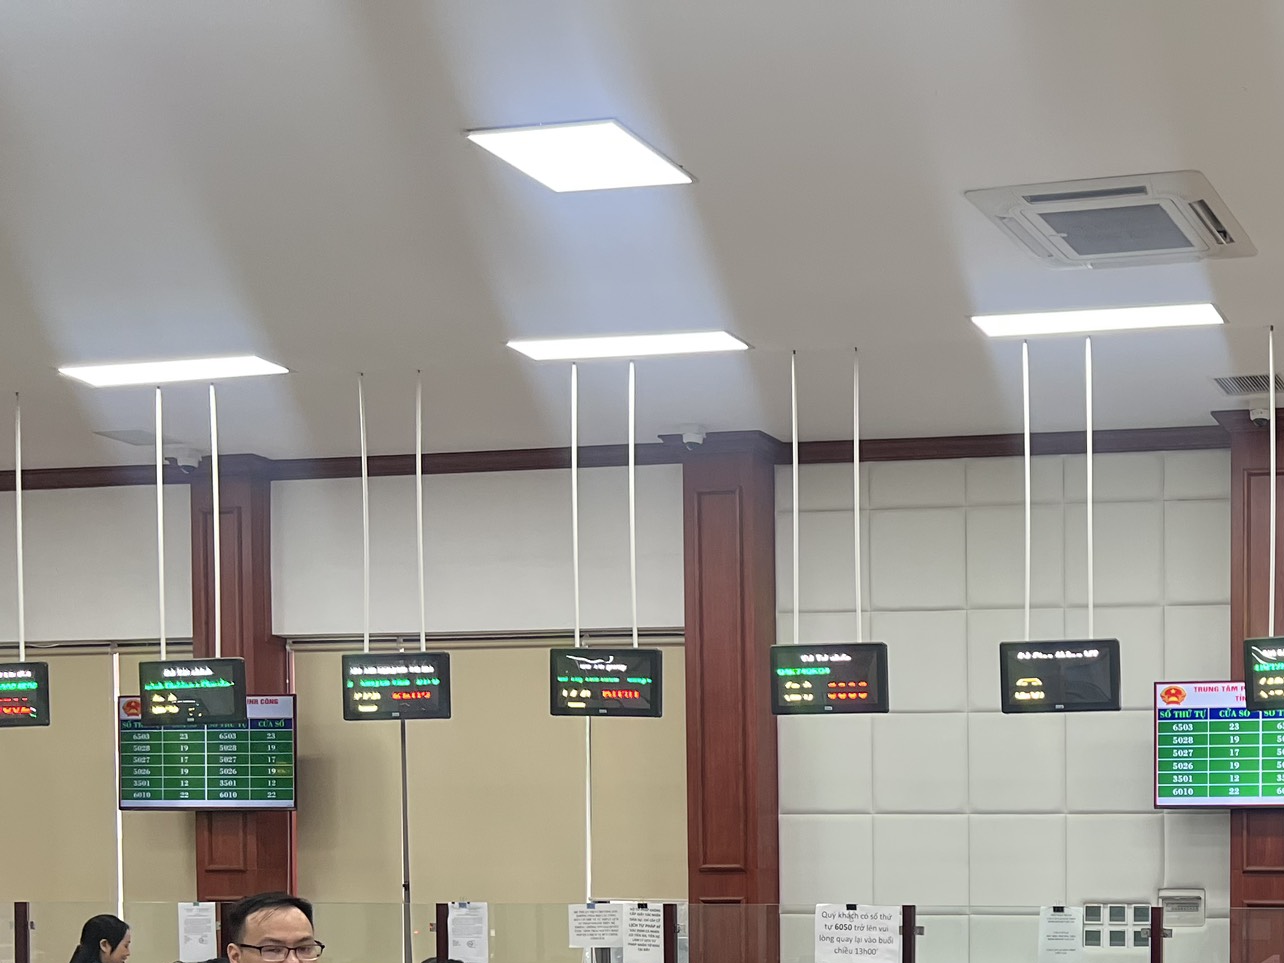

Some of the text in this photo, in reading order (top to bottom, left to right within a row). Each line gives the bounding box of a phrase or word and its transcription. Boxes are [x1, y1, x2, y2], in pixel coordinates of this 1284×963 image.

[1160, 708, 1206, 719] SỐ THỨ TỰ
[1219, 708, 1236, 717] CỬA
[822, 911, 836, 919] Quý
[819, 935, 834, 943] lòng
[834, 946, 853, 954] chiều
